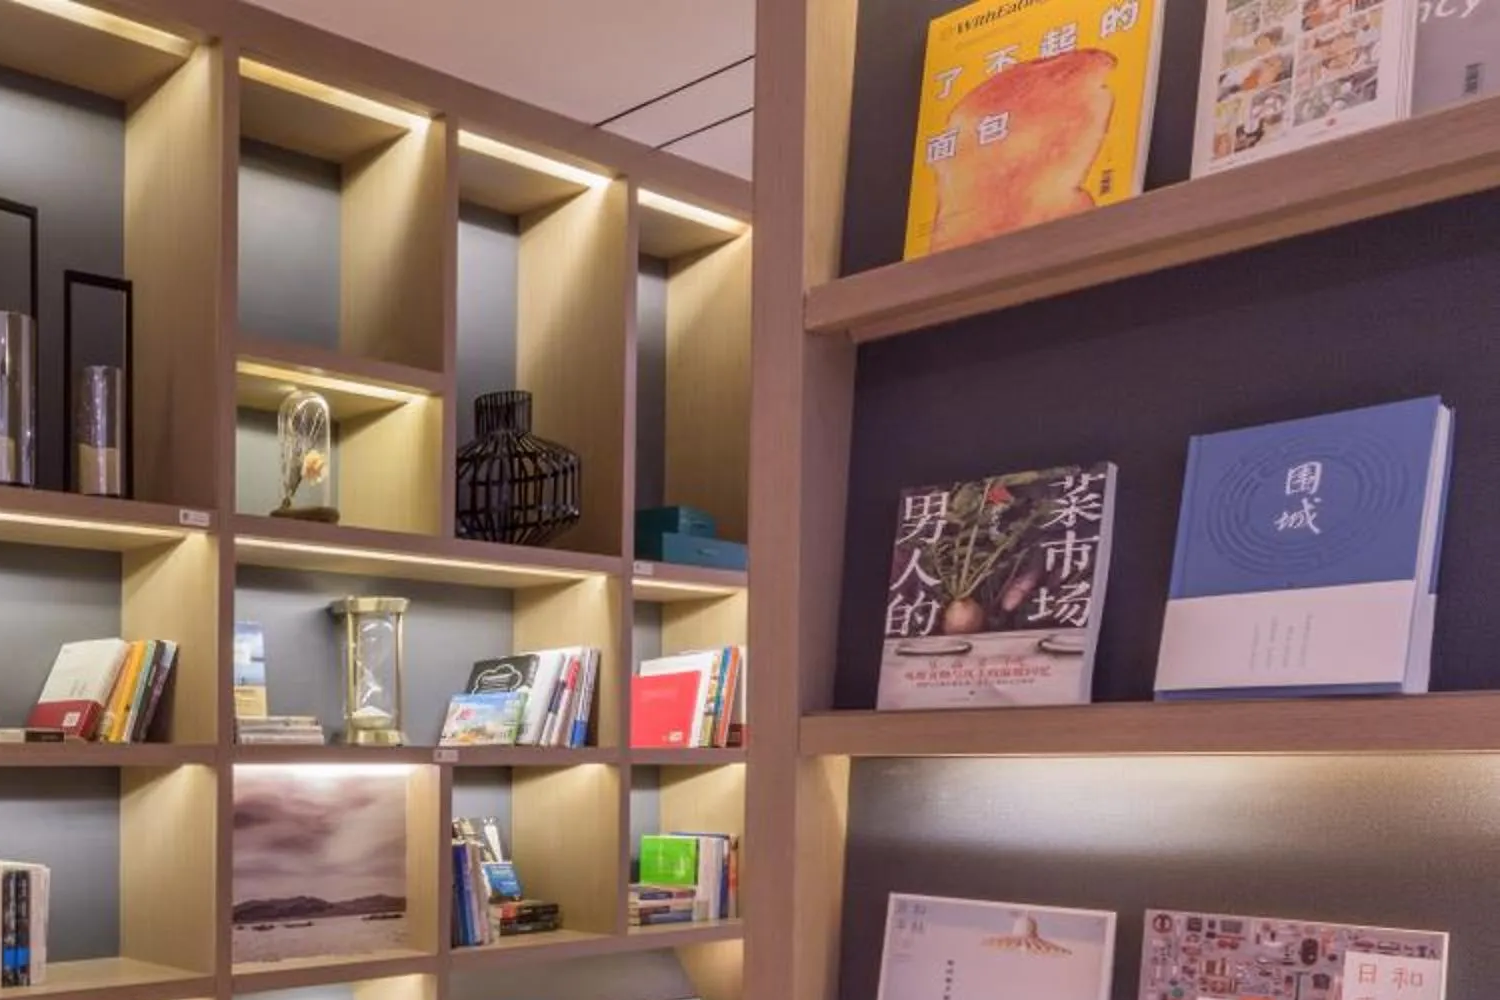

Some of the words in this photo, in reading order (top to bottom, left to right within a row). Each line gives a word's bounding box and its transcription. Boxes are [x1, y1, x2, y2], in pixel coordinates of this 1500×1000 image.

[927, 111, 1010, 163] 面包
[884, 491, 950, 636] 男人的
[1027, 472, 1106, 627] 菜市场
[1358, 962, 1424, 990] 日和
